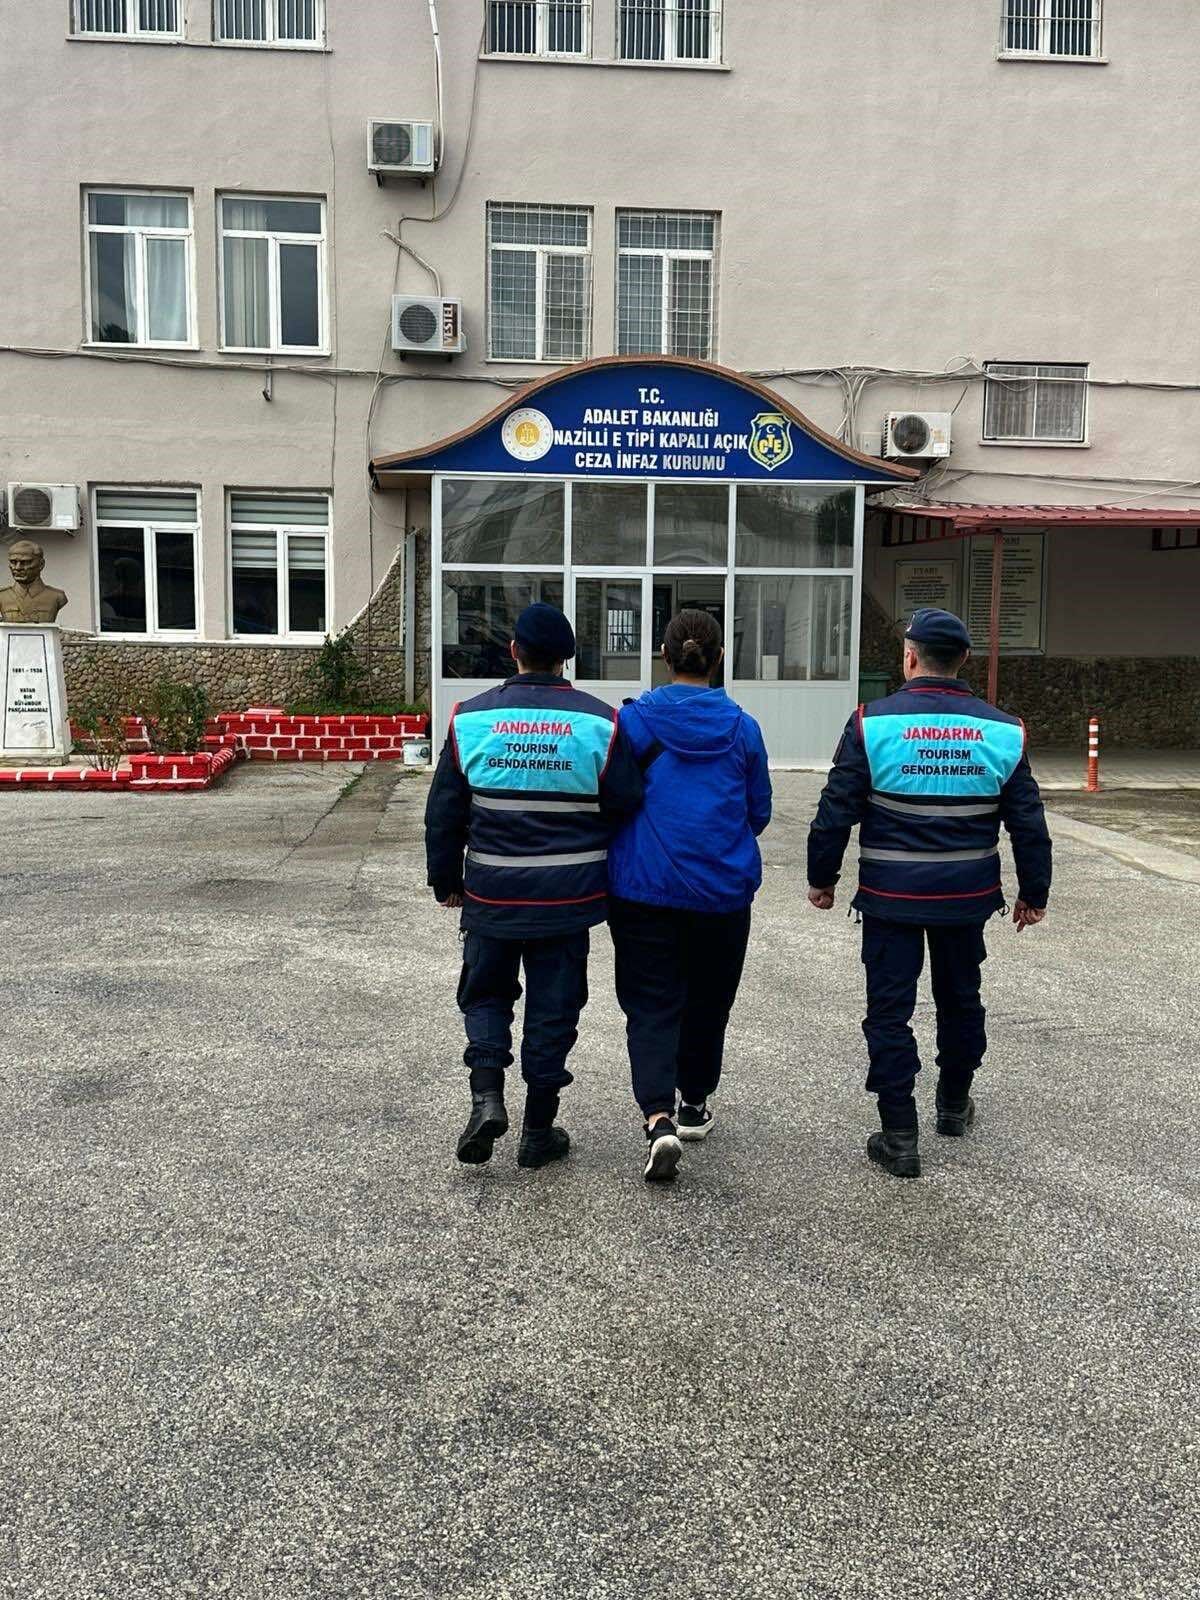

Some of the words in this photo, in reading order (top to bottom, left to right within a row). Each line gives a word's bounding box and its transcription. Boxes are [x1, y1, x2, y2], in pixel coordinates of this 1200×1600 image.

[638, 388, 665, 404] T.C.
[583, 408, 639, 425] ADALET
[642, 408, 719, 428] BAKANLIĞI
[553, 427, 608, 447] NAZİLLİ
[612, 431, 622, 447] E
[626, 428, 655, 448] TİPİ
[659, 432, 709, 450] KAPALI
[713, 433, 749, 454] AÇIK
[575, 452, 612, 469] CEZA
[616, 450, 658, 470] İNFAZ
[662, 454, 726, 471] KURUMU
[492, 721, 573, 736] JANDARMA
[903, 727, 985, 742] JANDARMA
[505, 742, 558, 755] TOURISM
[918, 749, 971, 760] TOURISM
[488, 758, 573, 771] GENDARMERIE
[901, 764, 986, 776] GENDARMERIE
